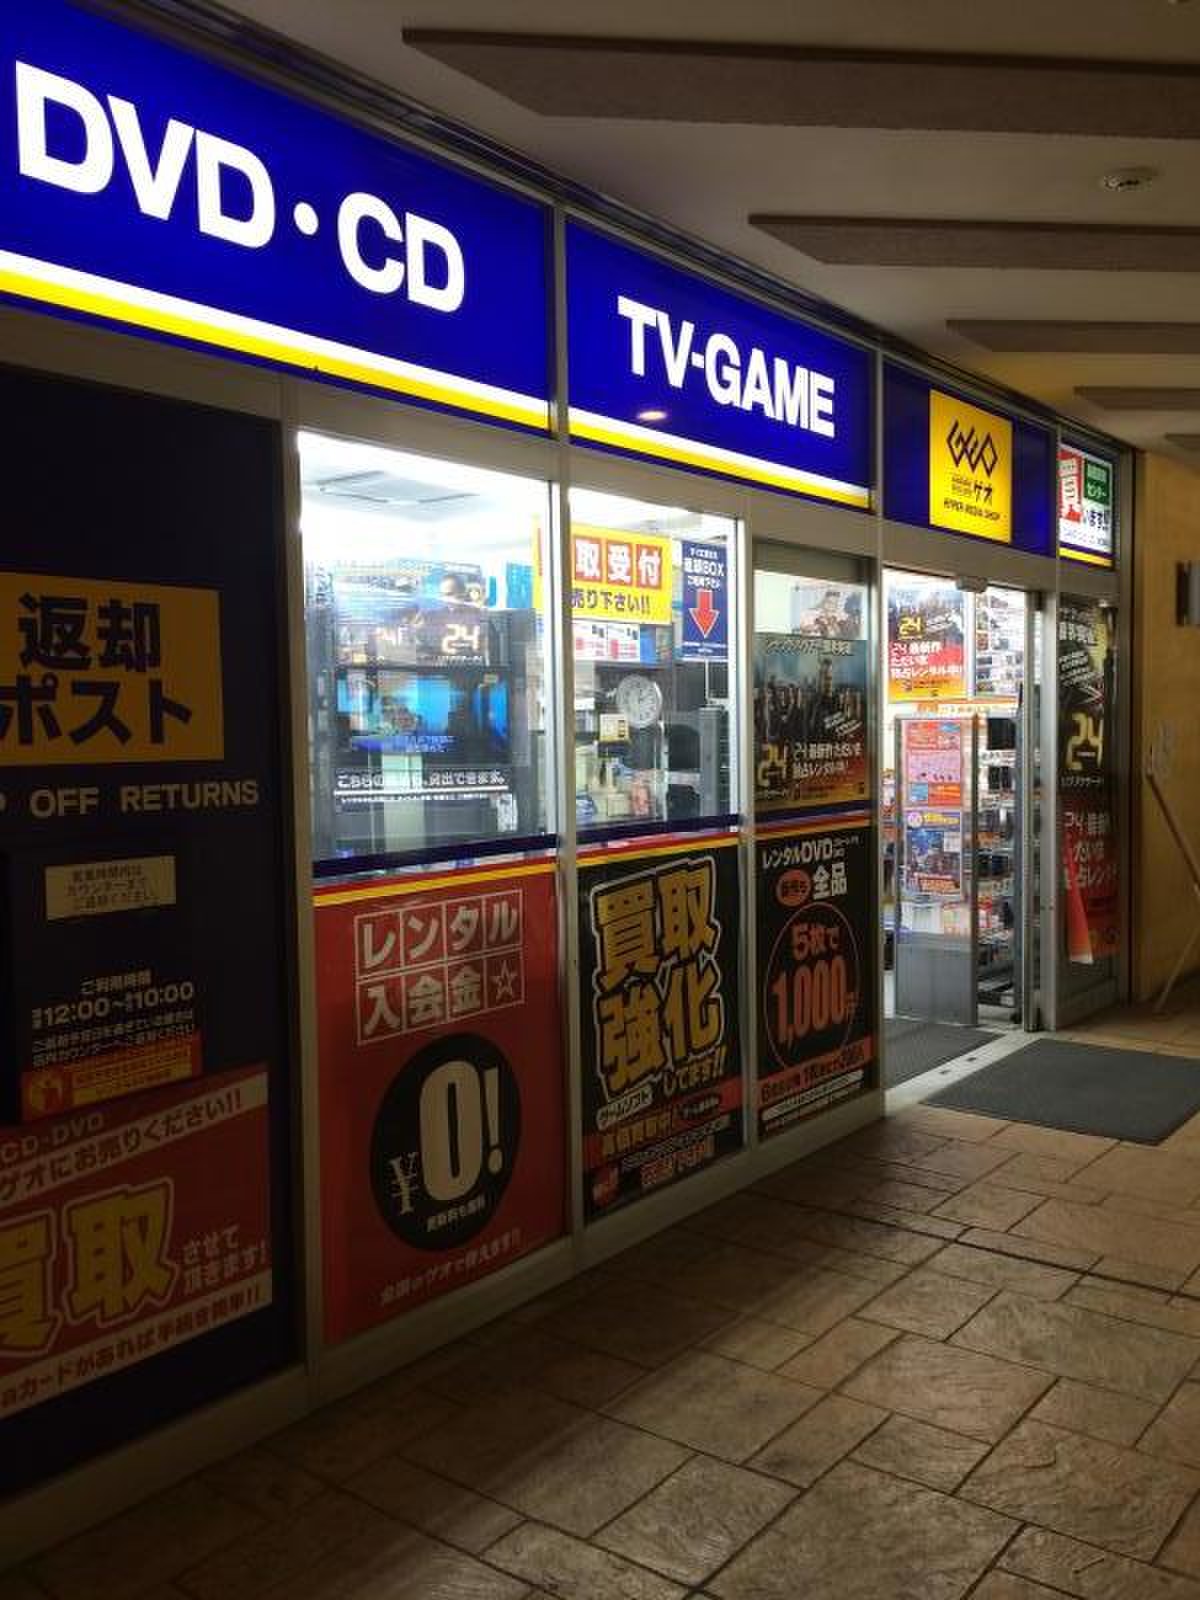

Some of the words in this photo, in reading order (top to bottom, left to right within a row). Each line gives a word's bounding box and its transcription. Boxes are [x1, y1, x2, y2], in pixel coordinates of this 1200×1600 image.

[617, 295, 835, 438] TV-GAME
[18, 592, 160, 673] 返却
[0, 672, 193, 746] ポスト
[30, 786, 99, 819] OFF
[120, 779, 259, 813] RETURNS
[812, 861, 848, 900] 全品
[362, 900, 519, 970] レンタル
[596, 866, 718, 992] 買取
[596, 960, 722, 1092] 強化
